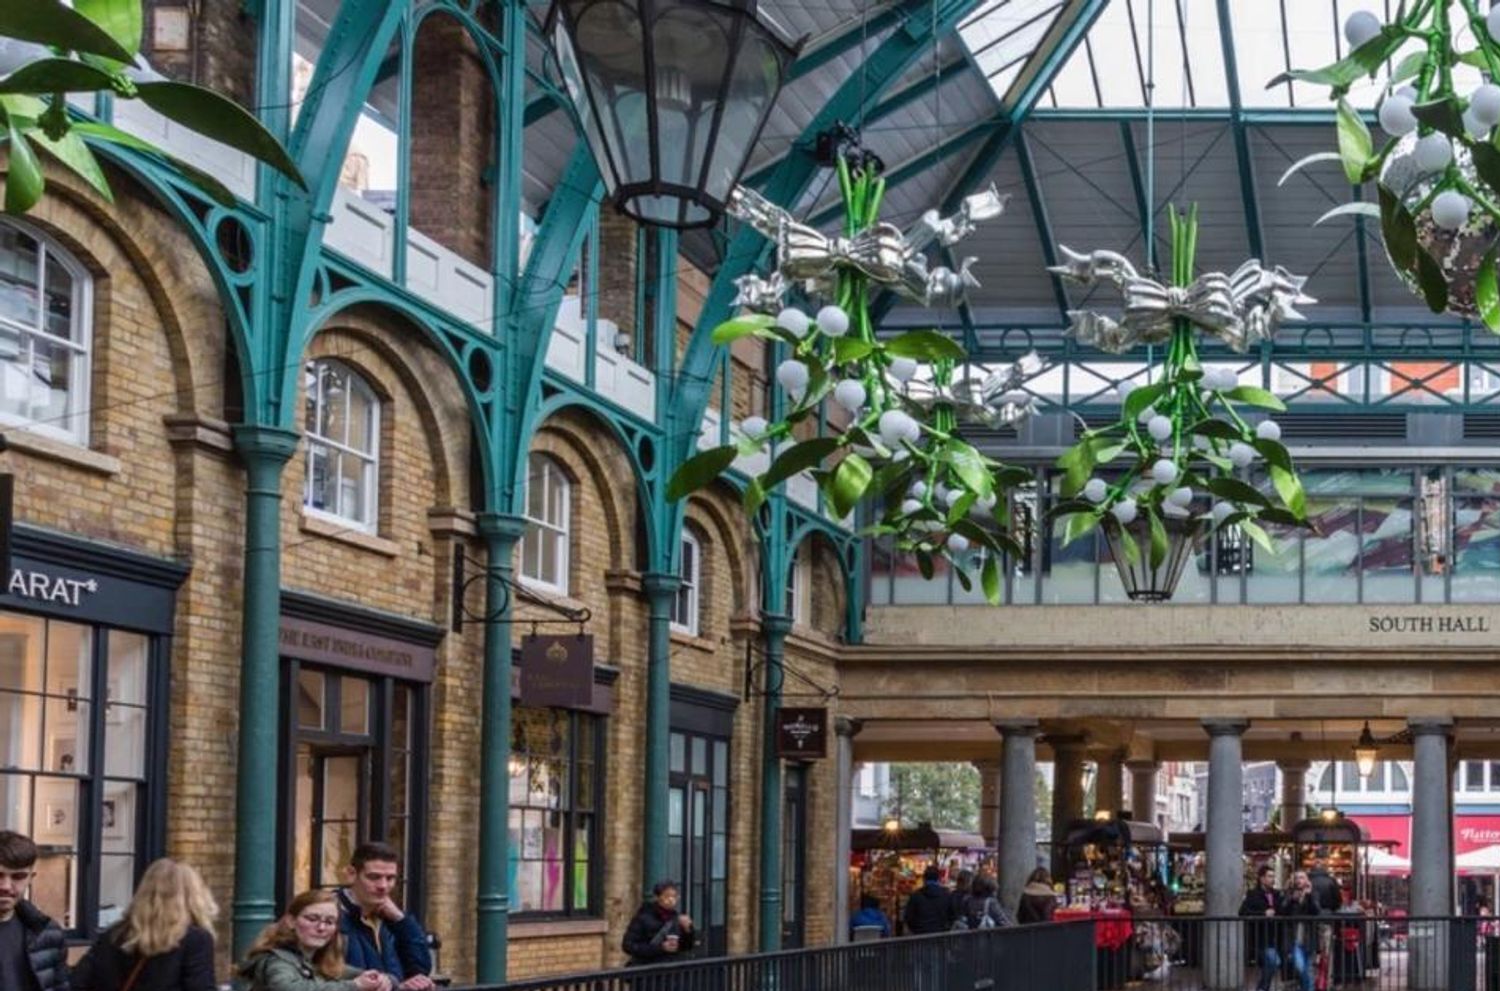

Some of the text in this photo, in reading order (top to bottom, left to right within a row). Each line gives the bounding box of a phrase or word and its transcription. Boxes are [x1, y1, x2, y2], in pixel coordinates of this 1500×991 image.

[8, 568, 98, 606] ARAT
[1369, 616, 1490, 632] SOUTH HALL
